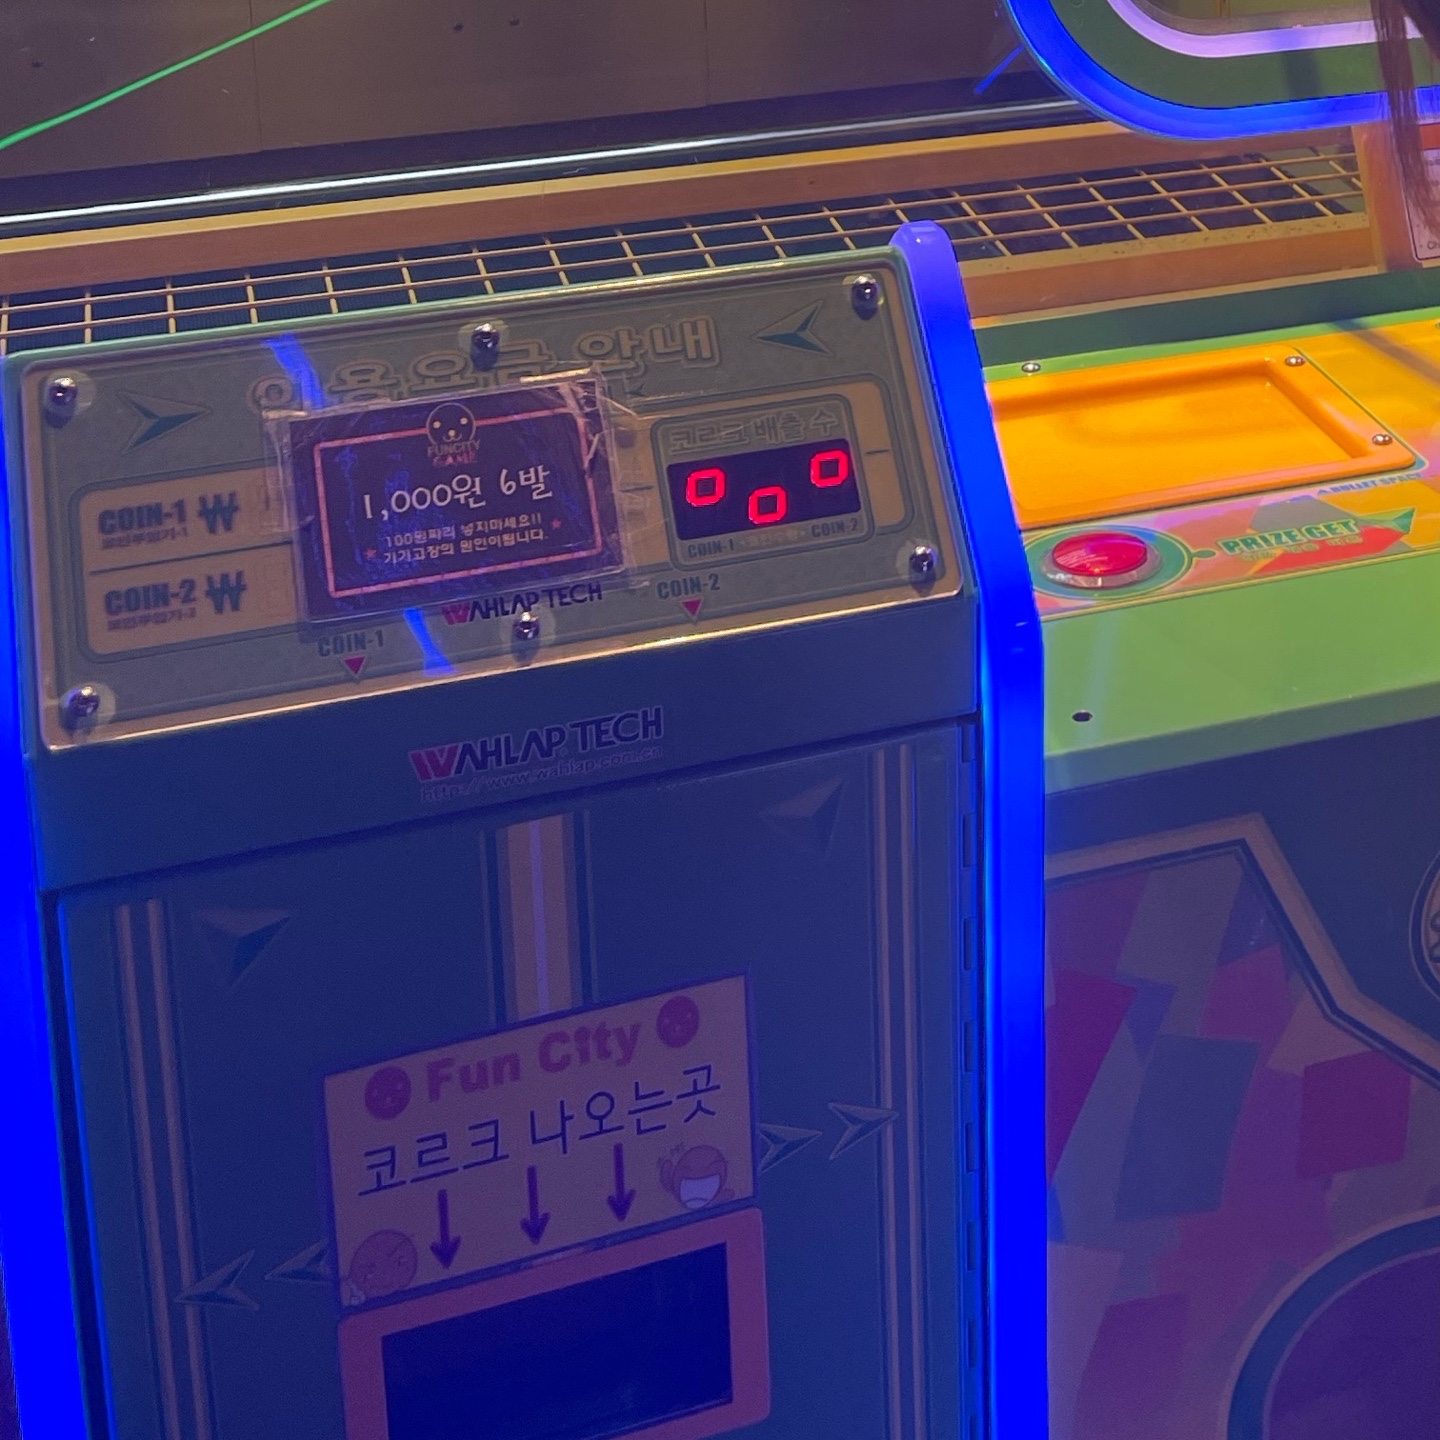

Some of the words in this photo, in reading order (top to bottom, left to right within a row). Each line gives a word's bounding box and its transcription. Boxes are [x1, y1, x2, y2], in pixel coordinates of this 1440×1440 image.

[364, 473, 487, 520] 1,000원
[500, 464, 553, 501] 6발
[98, 498, 188, 536] COIN-1
[688, 538, 734, 559] COIN-1
[811, 517, 859, 538] COIN-2
[1218, 528, 1300, 555] PRIZE
[1302, 518, 1360, 540] GET
[104, 578, 197, 616] COIN-2
[442, 592, 540, 626] WAHLAP
[541, 582, 603, 609] TECH
[657, 573, 721, 600] COIN-2
[317, 629, 386, 658] COIN-1
[408, 726, 567, 783] WAHLAP
[570, 705, 664, 753] TECH
[426, 1052, 521, 1102] Fun
[538, 1022, 640, 1073] City
[358, 1119, 510, 1197] 코르크
